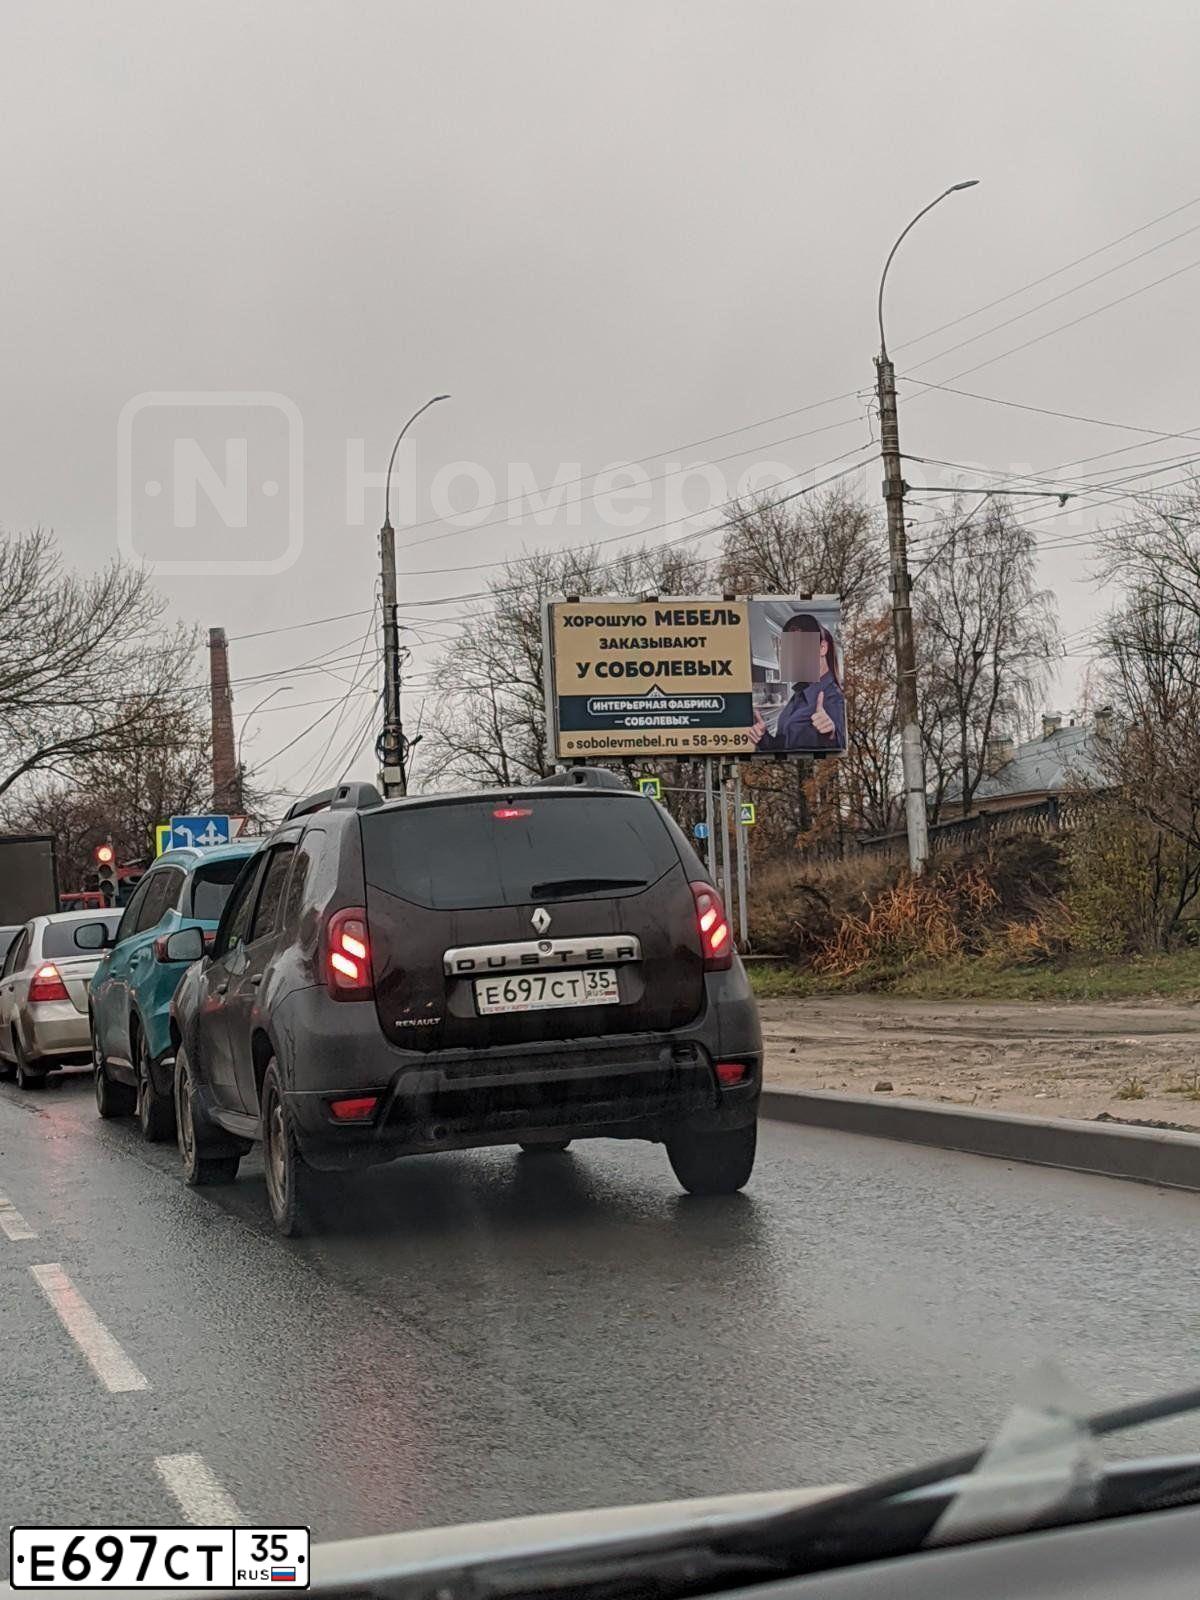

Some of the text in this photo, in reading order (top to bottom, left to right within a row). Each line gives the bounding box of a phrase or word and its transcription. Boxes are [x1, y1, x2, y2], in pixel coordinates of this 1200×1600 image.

[563, 609, 741, 628] ХОРОШУЮ МЕБЕЛЬ
[599, 636, 707, 650] ЗАКАЗЫВАЮТ
[576, 659, 733, 679] У СОБОЛЕВЫХ
[592, 697, 720, 711] ИНТЕРЬЕРНАЯ ФАБРИКА
[624, 715, 690, 726] СОБОЛЕВЫХ
[576, 734, 749, 750] sobolevmebel.ru 58-99-89
[456, 946, 635, 971] DUSTER
[586, 971, 610, 989] 35
[395, 1017, 441, 1028] RENAULT
